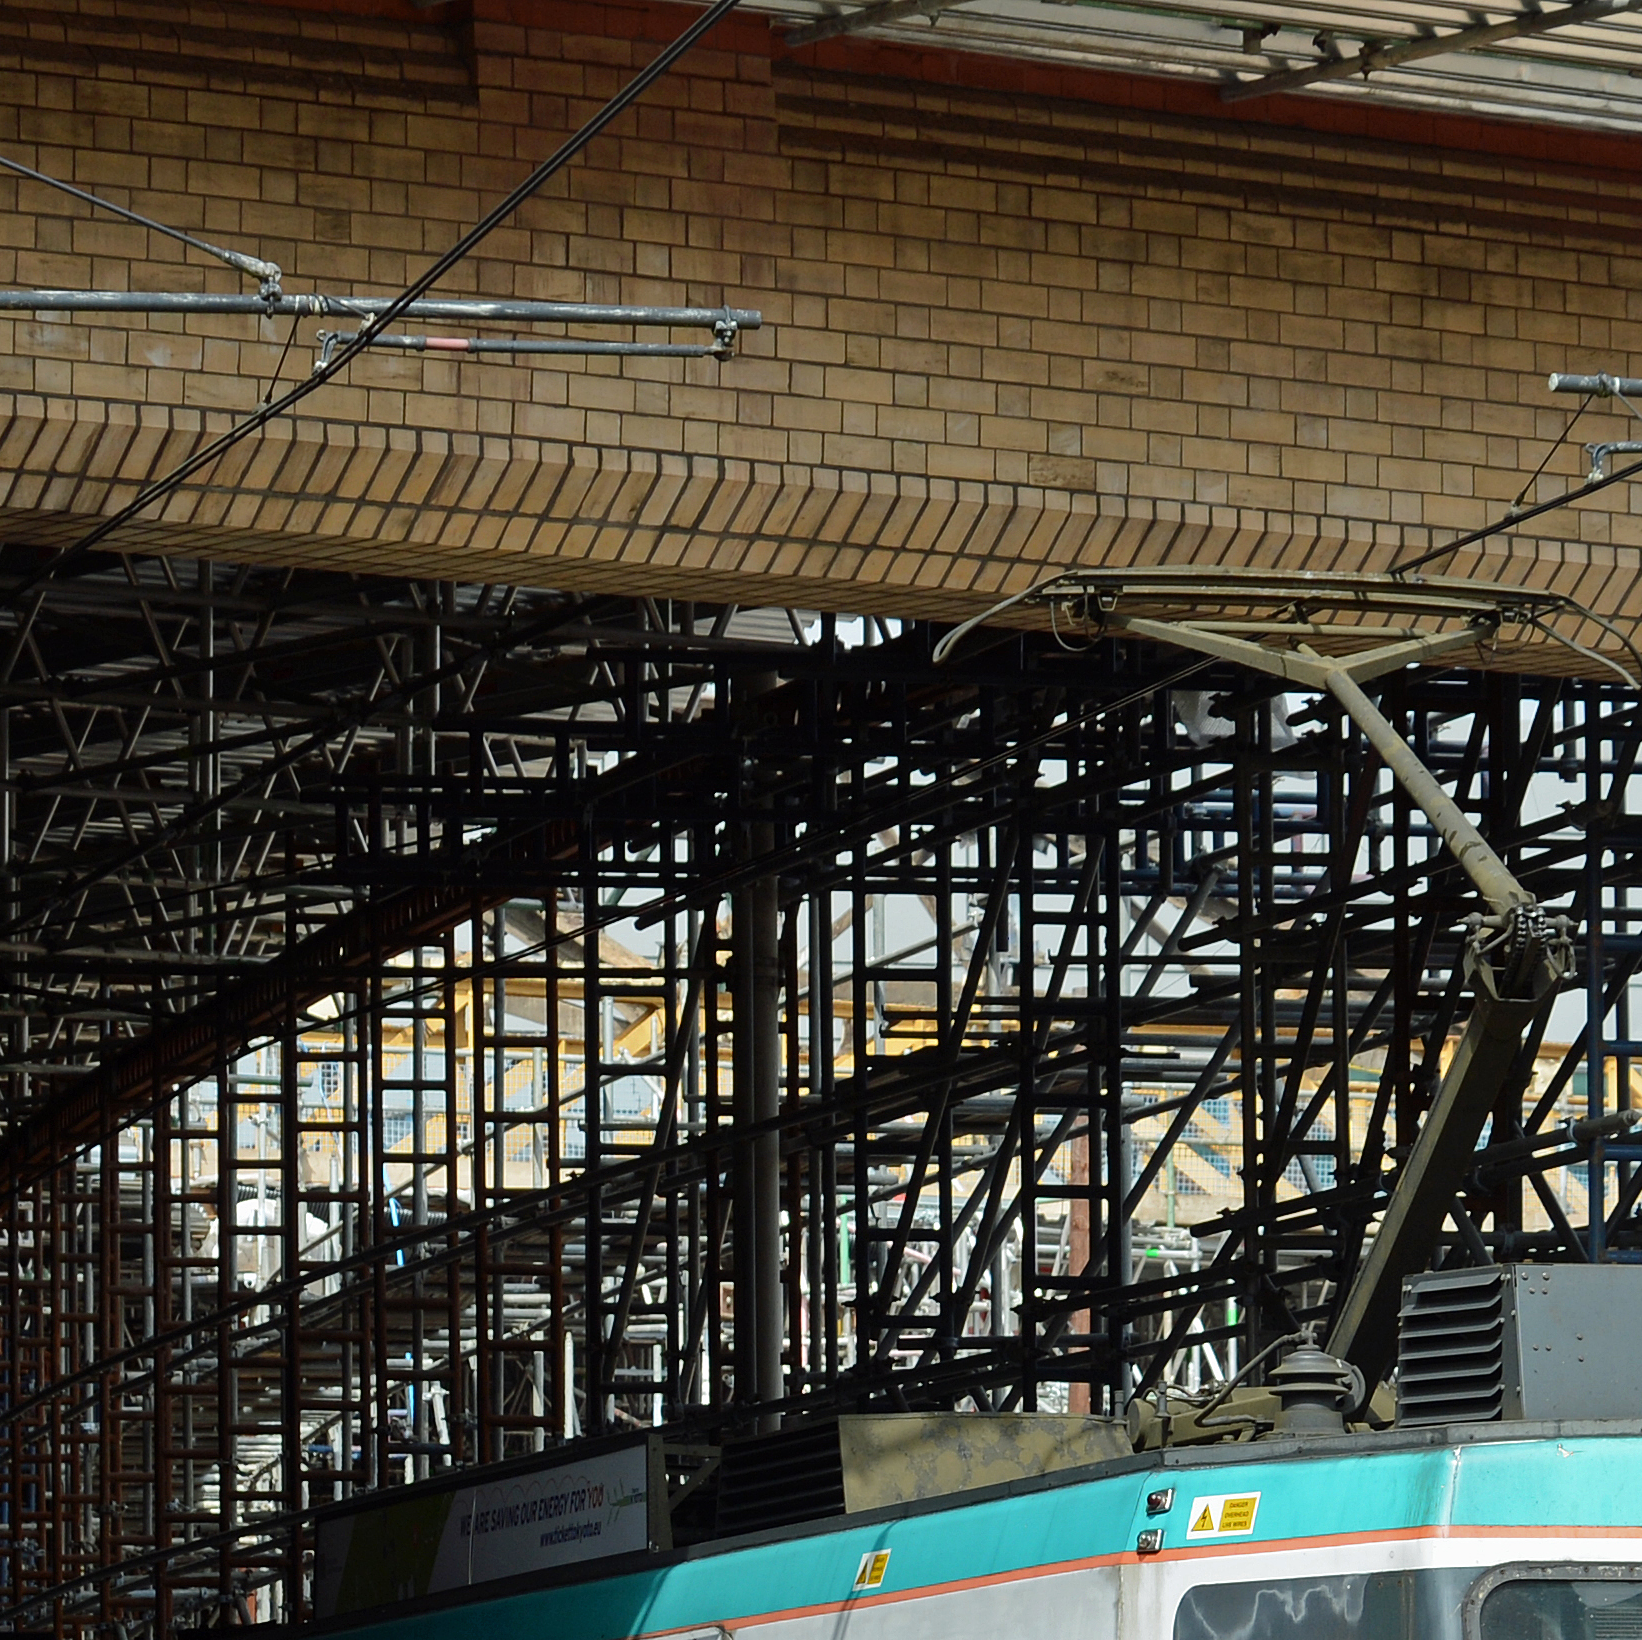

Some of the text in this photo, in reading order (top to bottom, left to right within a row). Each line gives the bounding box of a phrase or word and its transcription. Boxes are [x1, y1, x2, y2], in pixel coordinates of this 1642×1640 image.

[474, 1510, 490, 1535] ARE
[491, 1503, 520, 1531] SAVING
[520, 1500, 538, 1526] OUR
[539, 1494, 569, 1521] ENERGY
[570, 1488, 586, 1513] FOR
